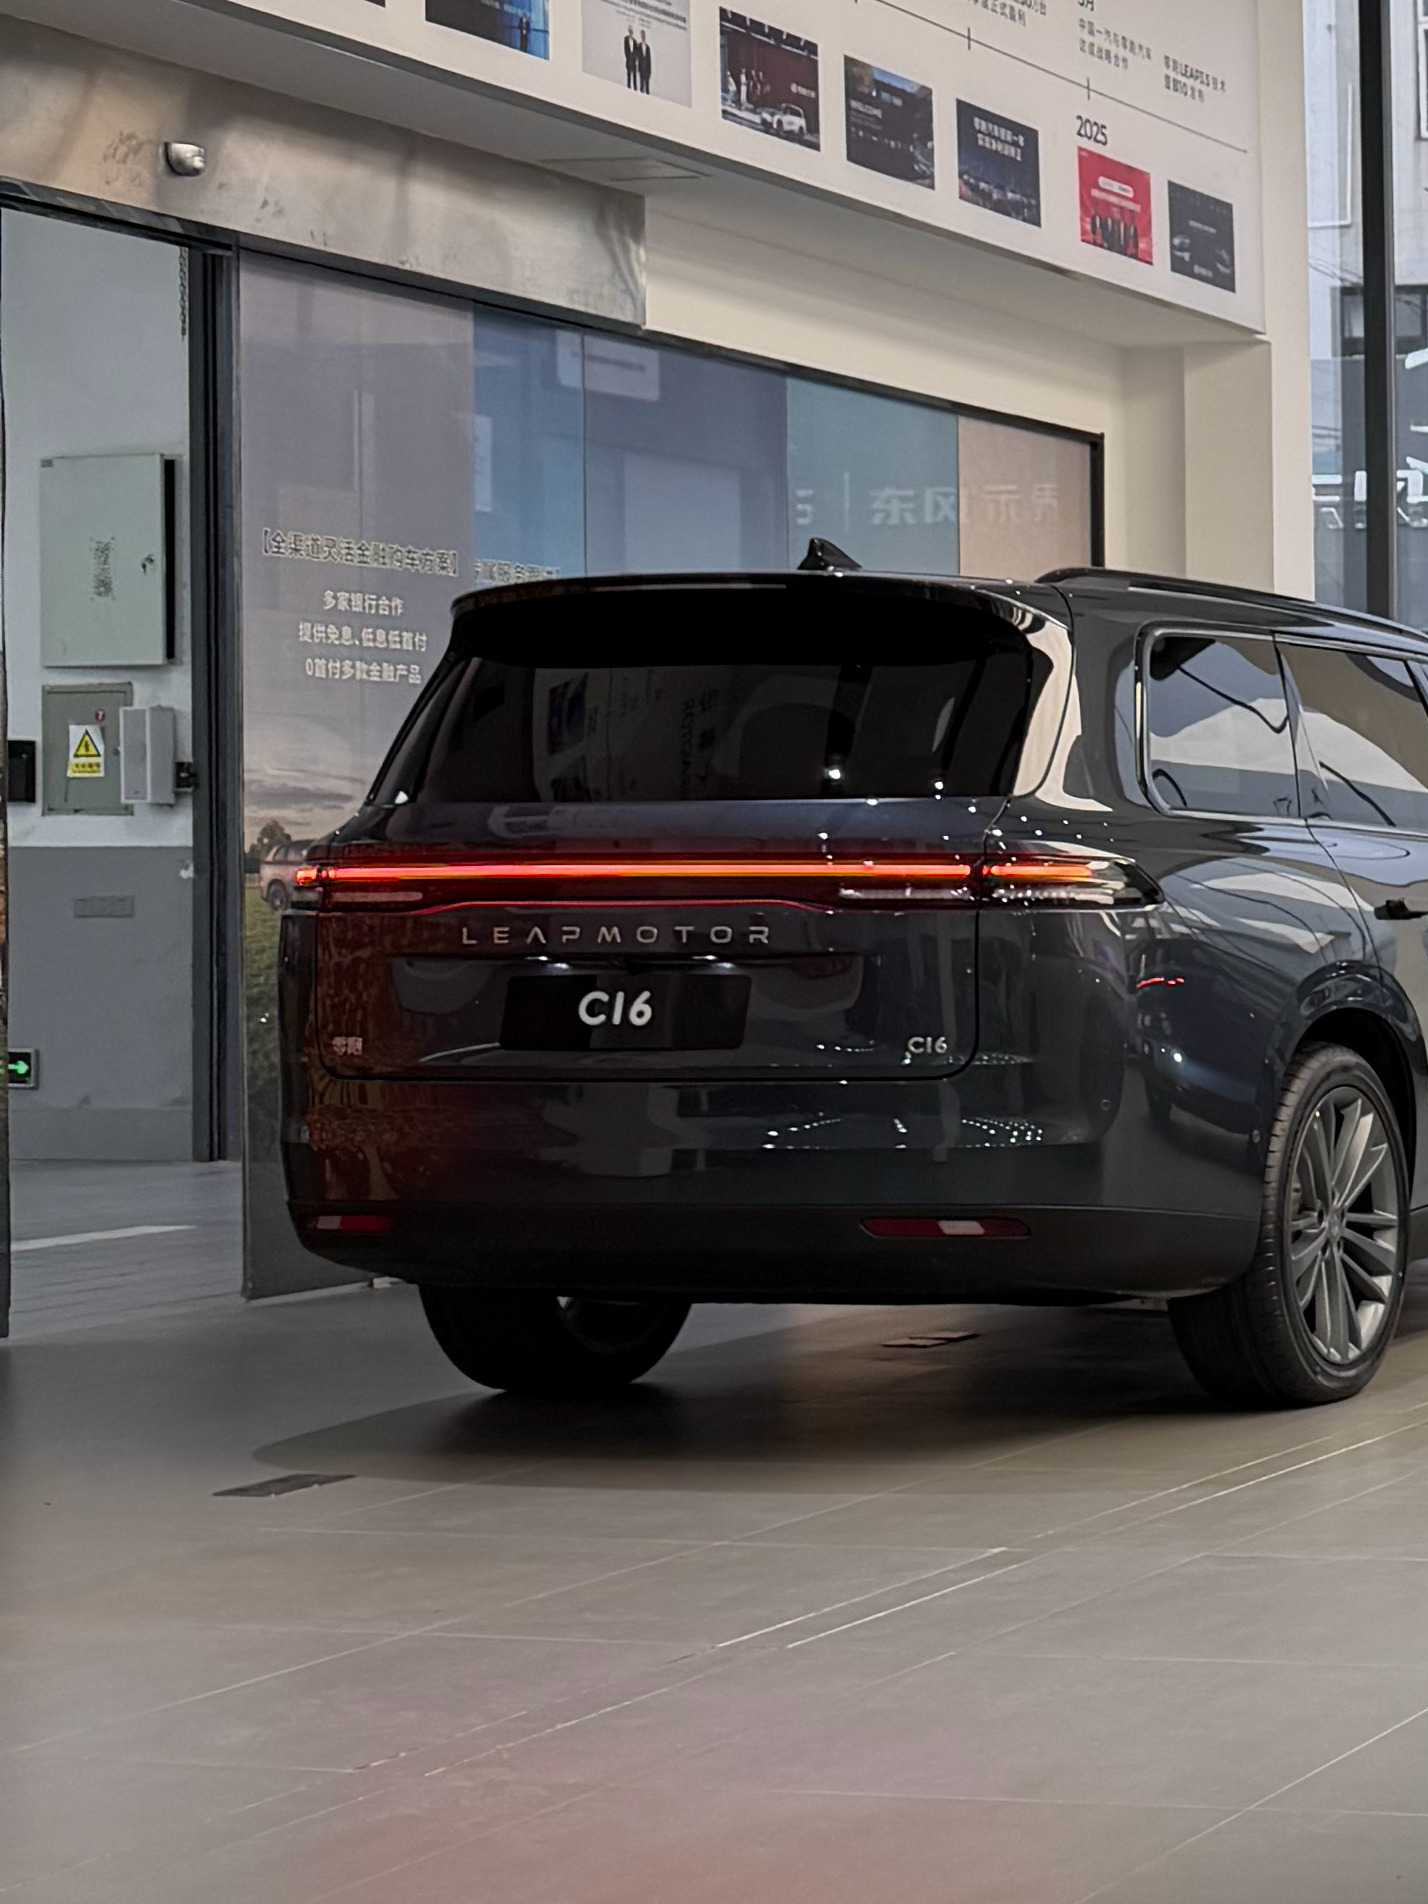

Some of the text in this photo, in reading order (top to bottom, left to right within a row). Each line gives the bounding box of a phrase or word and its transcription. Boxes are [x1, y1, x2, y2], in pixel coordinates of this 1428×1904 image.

[1075, 114, 1109, 146] 2025
[322, 589, 405, 617] 多家银行合作
[305, 658, 423, 685] 0首付多款金融产品
[460, 925, 771, 947] LEAPMOTOR
[578, 989, 654, 1027] C16
[907, 1035, 949, 1055] C16
